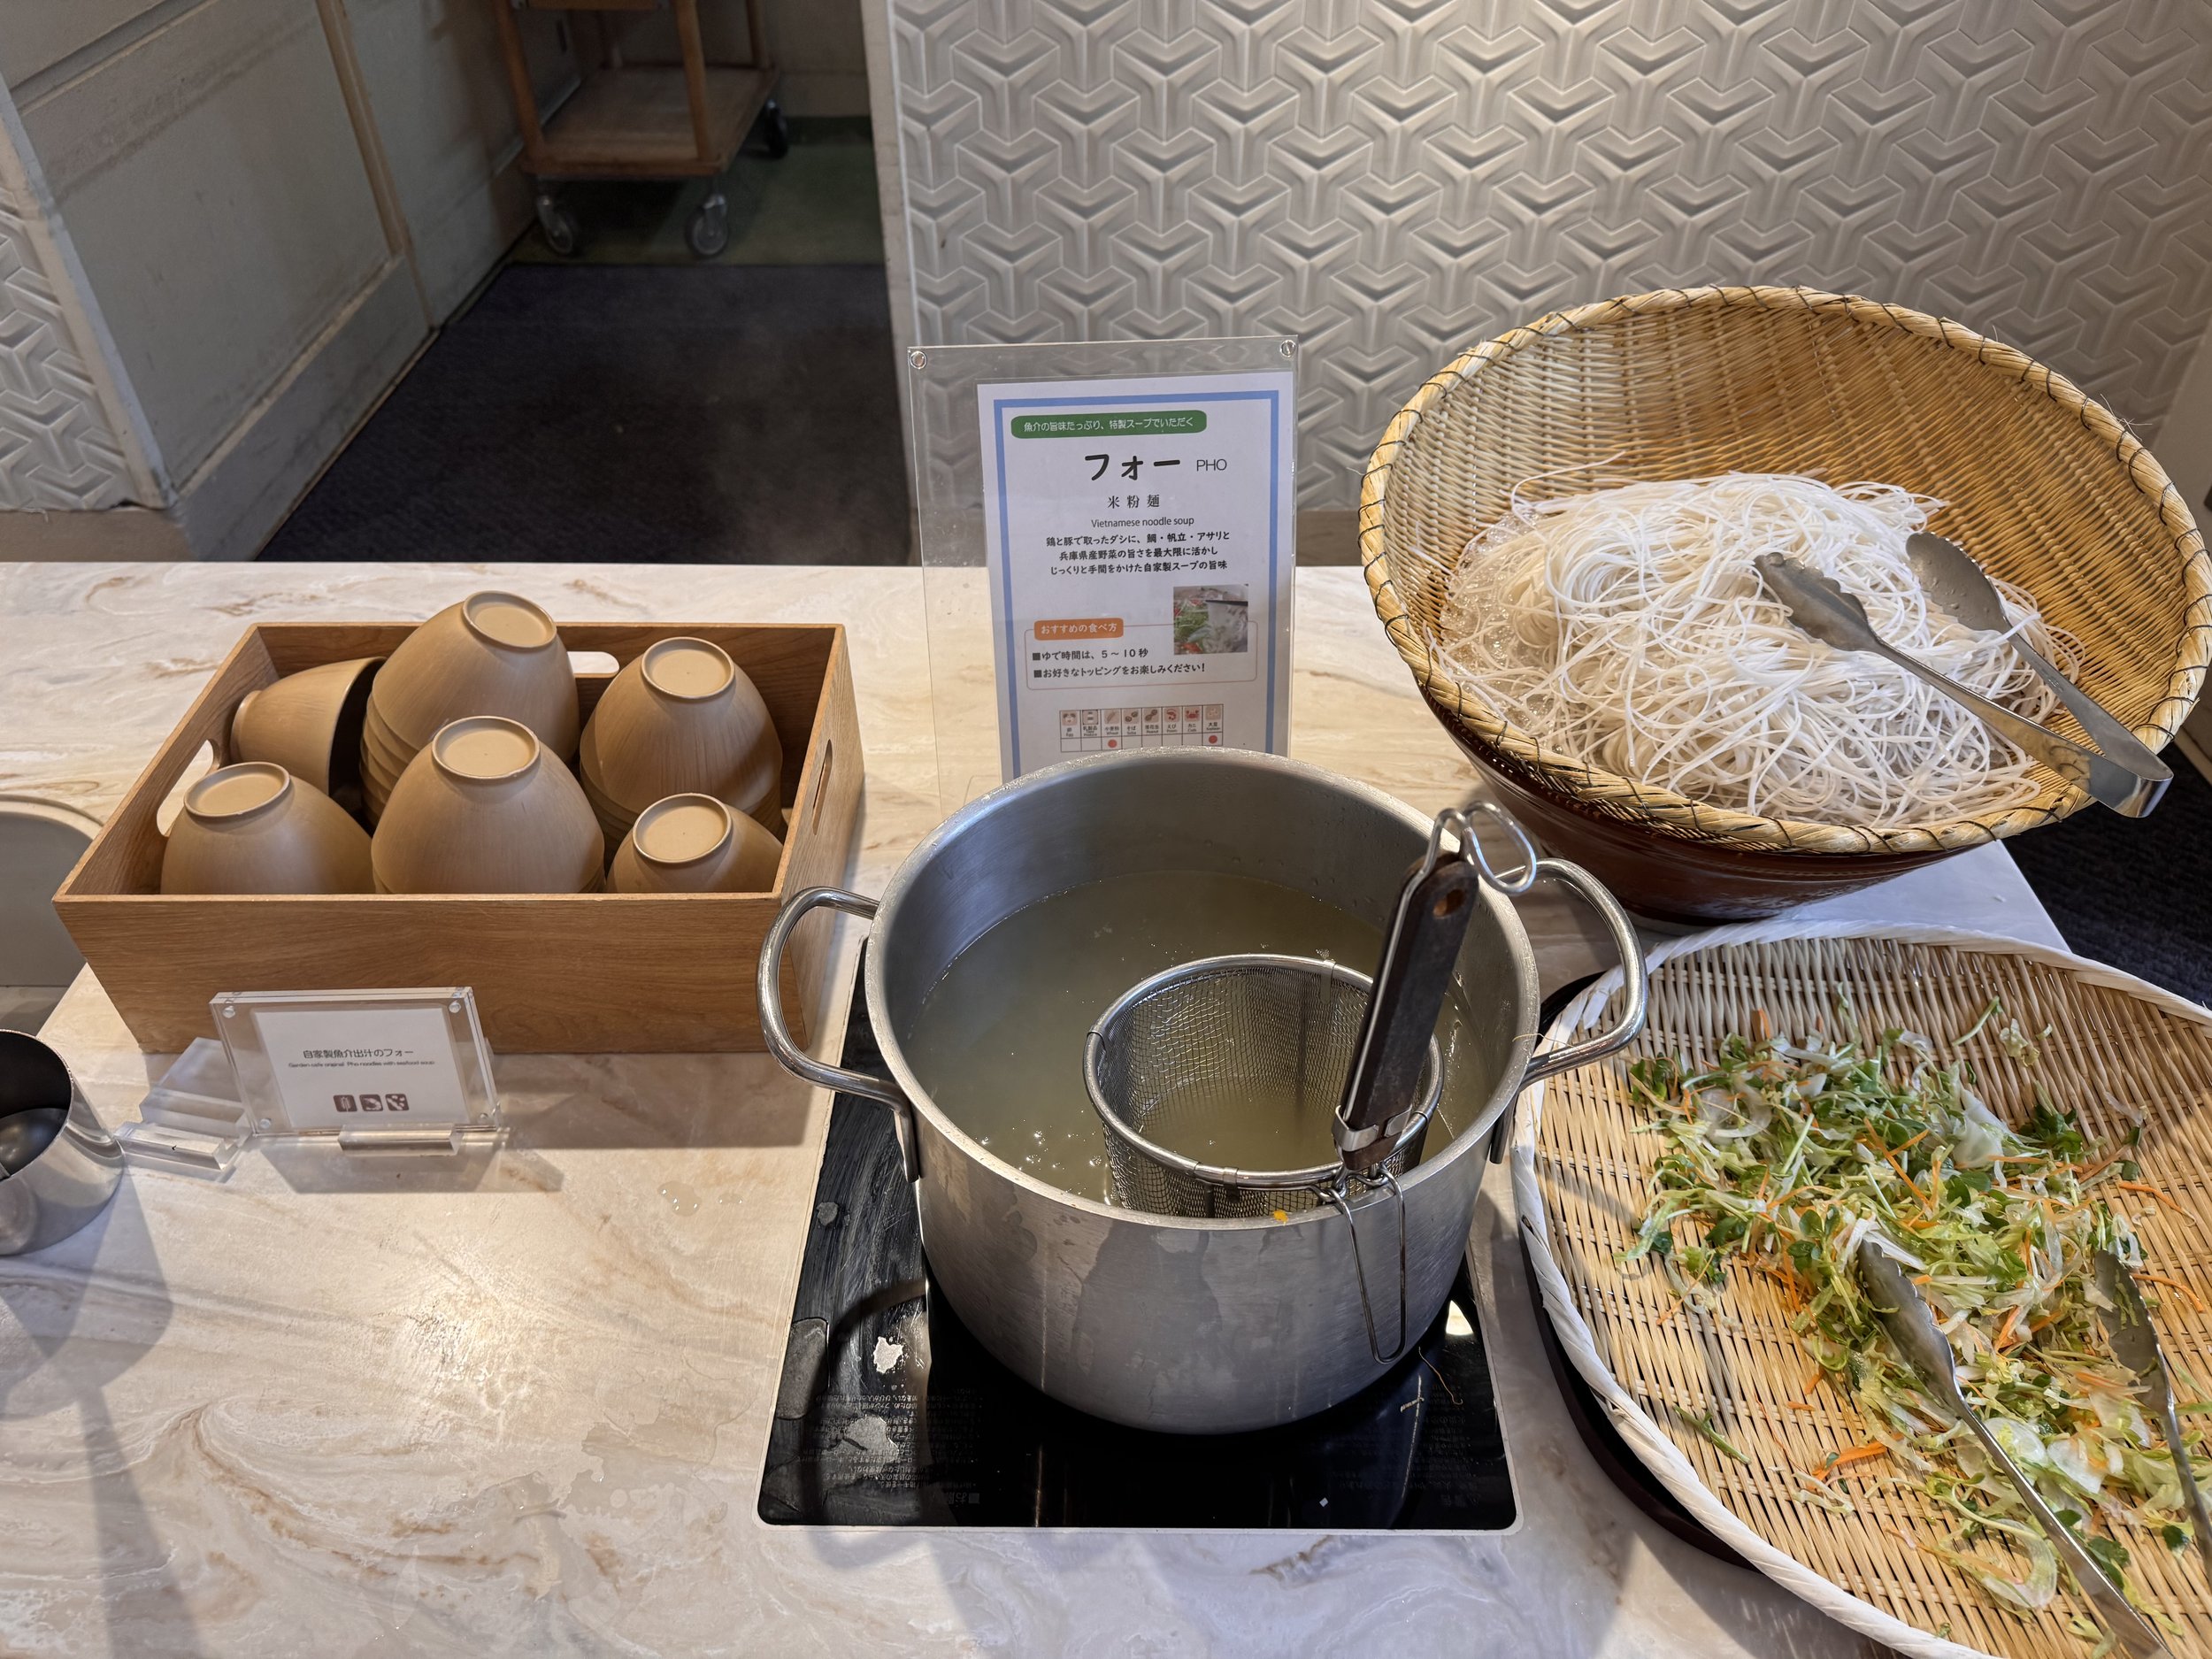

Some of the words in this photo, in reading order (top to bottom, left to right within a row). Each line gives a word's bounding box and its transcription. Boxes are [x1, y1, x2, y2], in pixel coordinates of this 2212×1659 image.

[1024, 417, 1193, 432] 魚介の旨味たっぷり、特製スープでいただく
[1085, 454, 1180, 480] フォー
[1196, 458, 1227, 472] PHO
[1142, 517, 1171, 526] noodle
[1173, 518, 1194, 526] soup
[1059, 546, 1217, 561] 兵庫県産野菜の旨さを最大限に活かし
[1051, 560, 1227, 574] じっくりと手間をかけた自家製スープの旨味
[1041, 623, 1117, 634] おすすめの食べ方
[302, 1048, 414, 1059] 自家製魚介出汁のフォー
